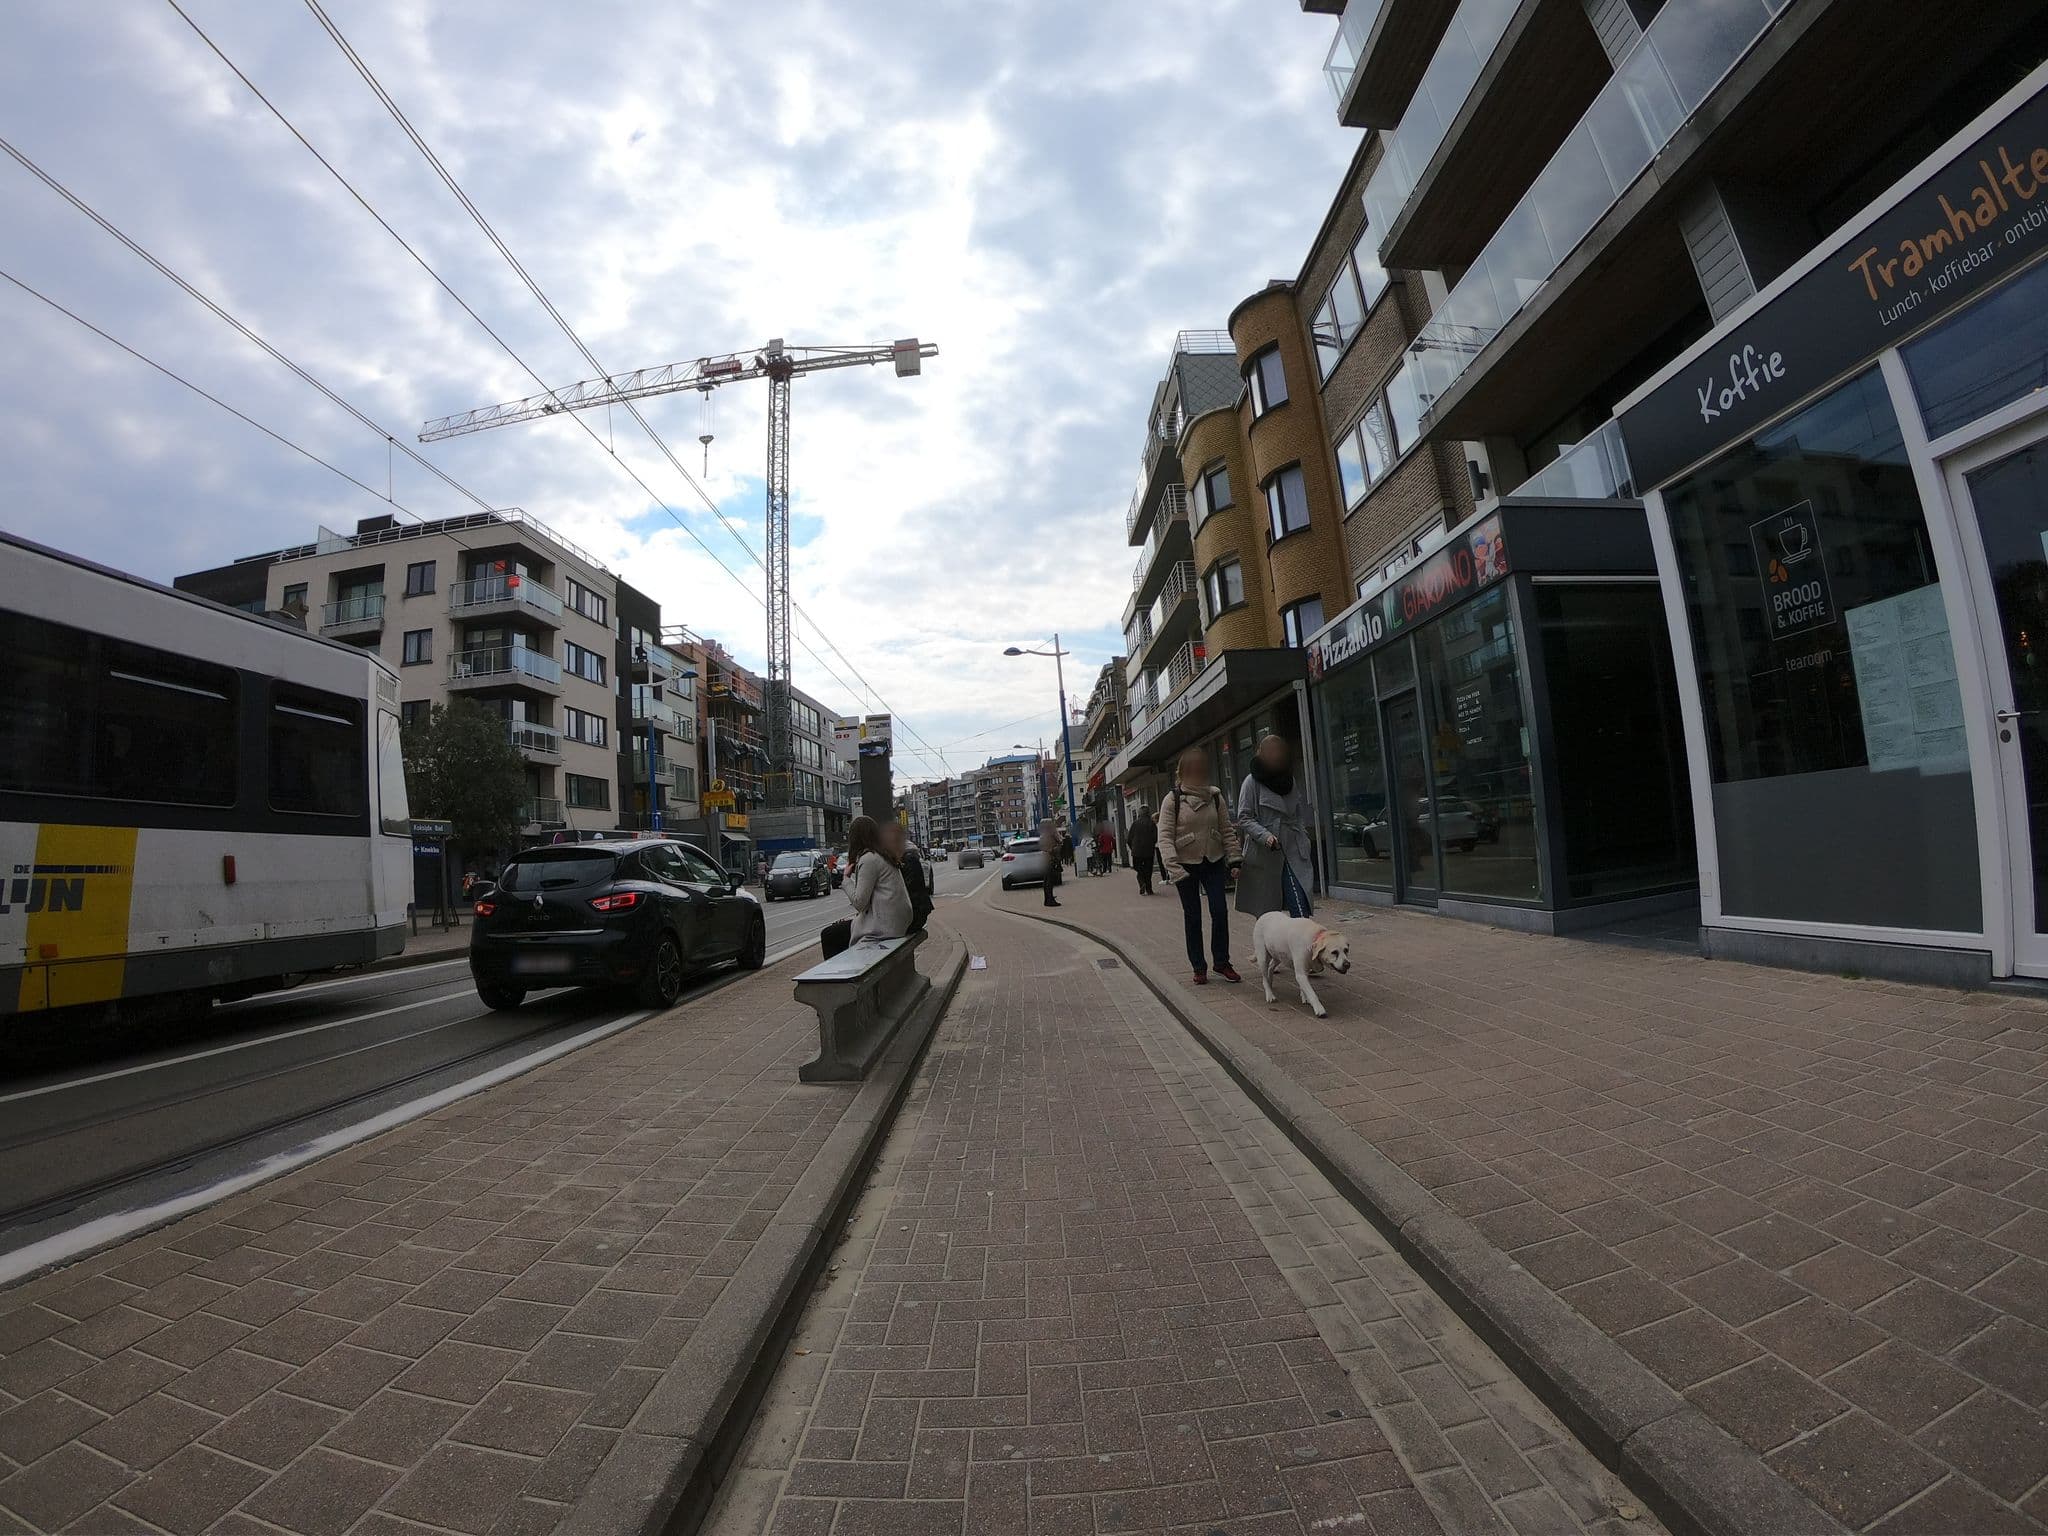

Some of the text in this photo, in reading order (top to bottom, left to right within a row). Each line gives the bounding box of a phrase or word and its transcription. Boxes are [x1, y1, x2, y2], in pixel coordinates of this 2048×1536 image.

[1847, 146, 2048, 300] Tramhalte
[1878, 291, 1922, 326] Lunch
[1928, 242, 1996, 295] koffiebar
[1698, 344, 1786, 424] Koffie
[1773, 581, 1822, 612] BROOD
[1778, 601, 1826, 629] & KOFFIE
[1319, 612, 1383, 671] Pizzaiolo
[1785, 650, 1833, 672] tearoom
[14, 865, 31, 873] DE
